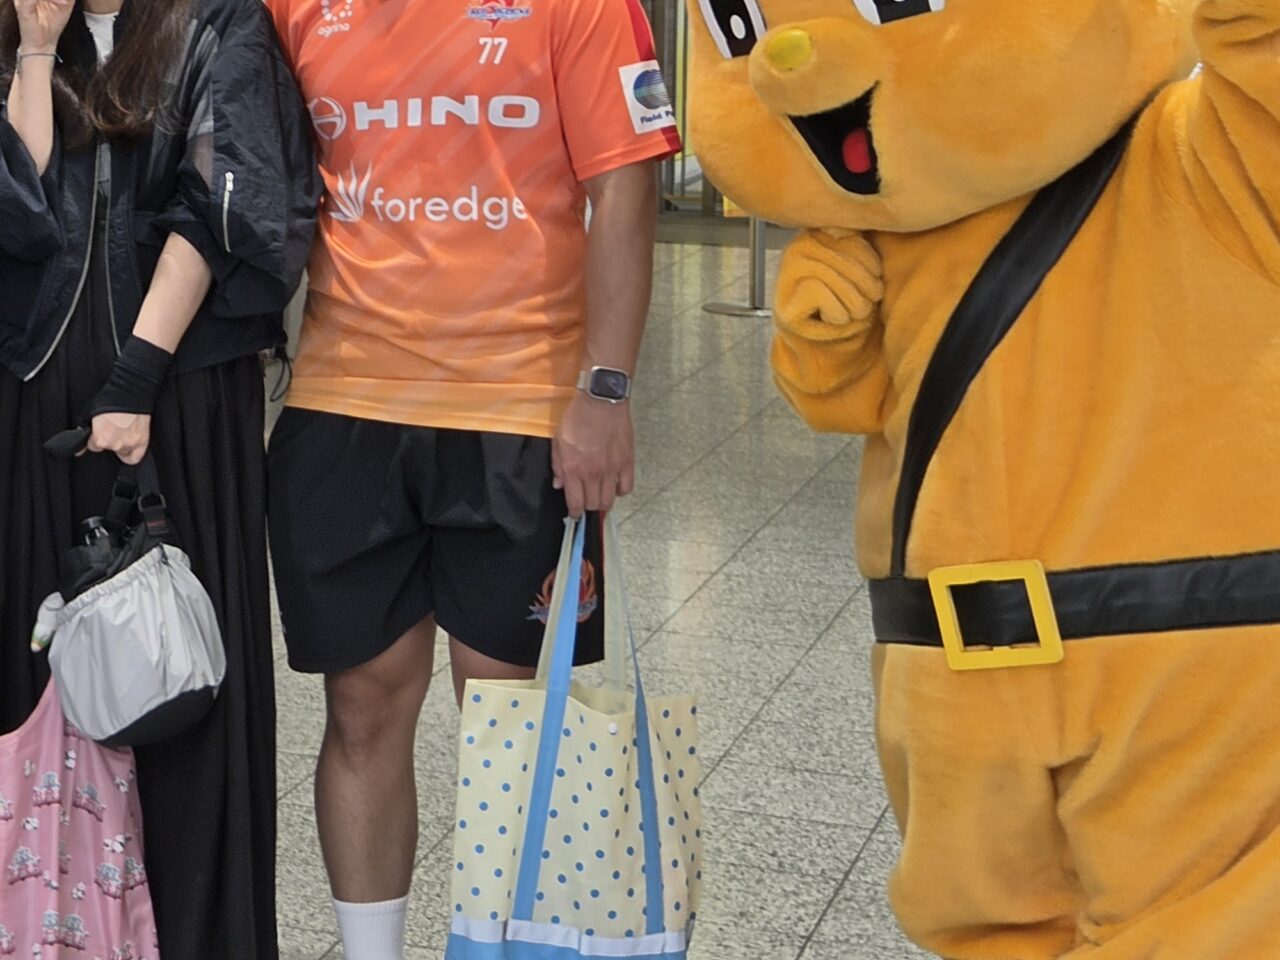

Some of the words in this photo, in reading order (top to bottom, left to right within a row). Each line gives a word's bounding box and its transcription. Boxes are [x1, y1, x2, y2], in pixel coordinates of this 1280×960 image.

[478, 36, 509, 65] 77
[353, 95, 541, 130] HINO
[370, 185, 528, 230] foredge
